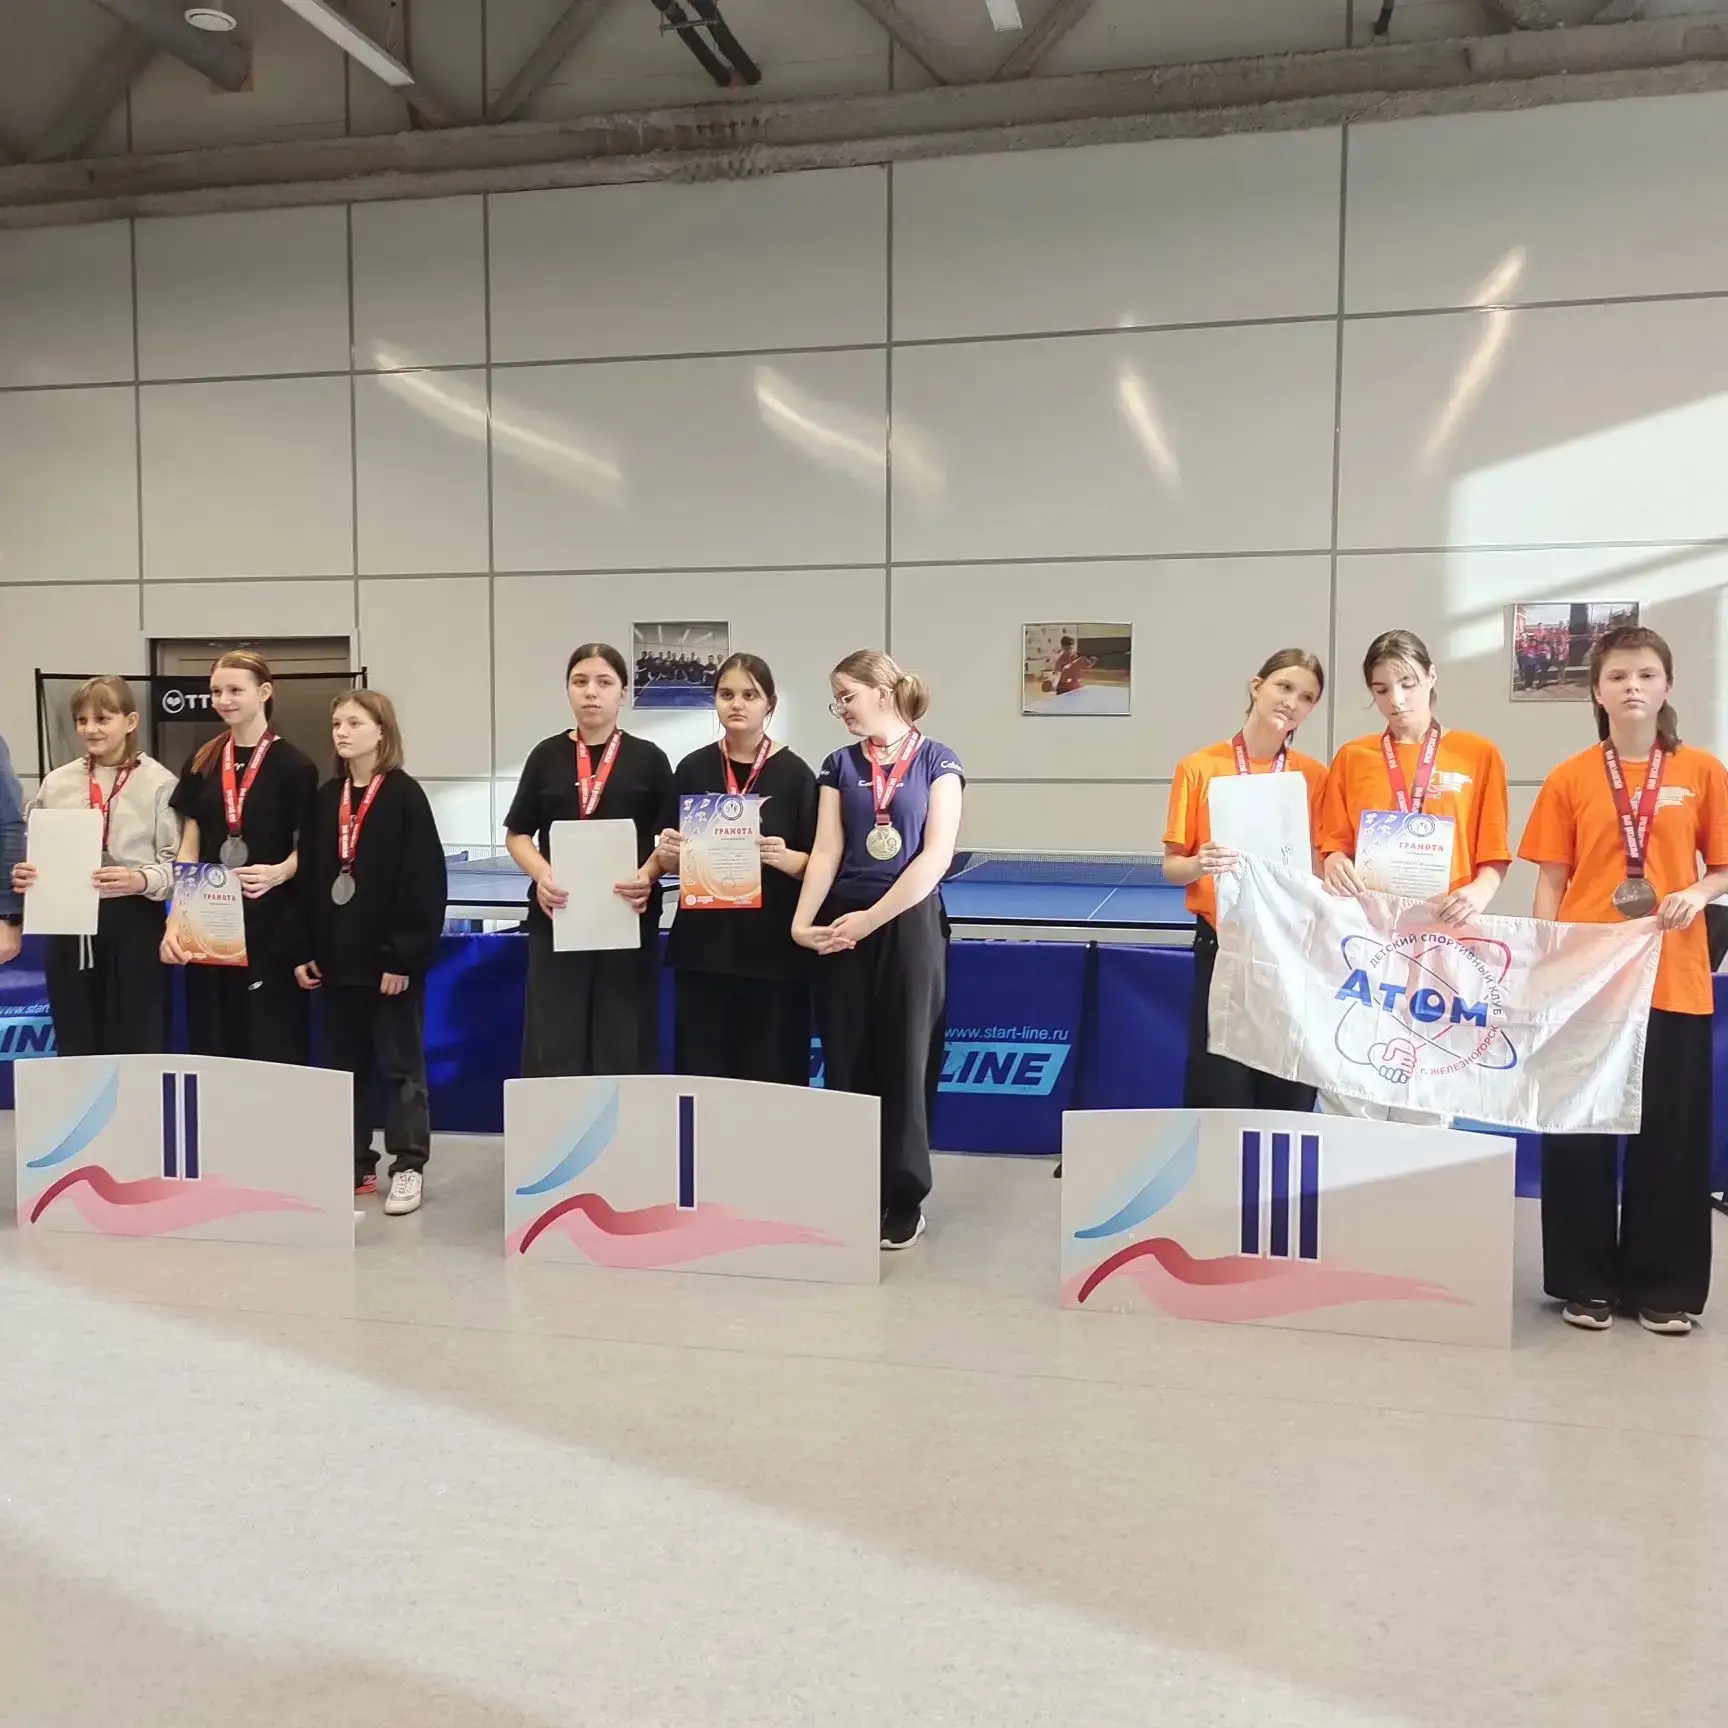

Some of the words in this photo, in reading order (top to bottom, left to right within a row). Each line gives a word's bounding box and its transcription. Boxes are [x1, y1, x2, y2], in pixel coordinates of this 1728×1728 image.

[714, 827, 753, 835] ГРАМОТА
[1399, 841, 1444, 852] ГРАМОТА
[1370, 932, 1418, 969] ДЕТСКИЙ
[1420, 933, 1495, 985] СПОРТИВНЫЙ
[1488, 985, 1503, 1016] КЛУБ
[1335, 968, 1489, 1027] АТОМ
[945, 1025, 1069, 1041] www.start-line.ru
[1430, 1025, 1499, 1077] ЖЕЛЕЗНОГОРСК
